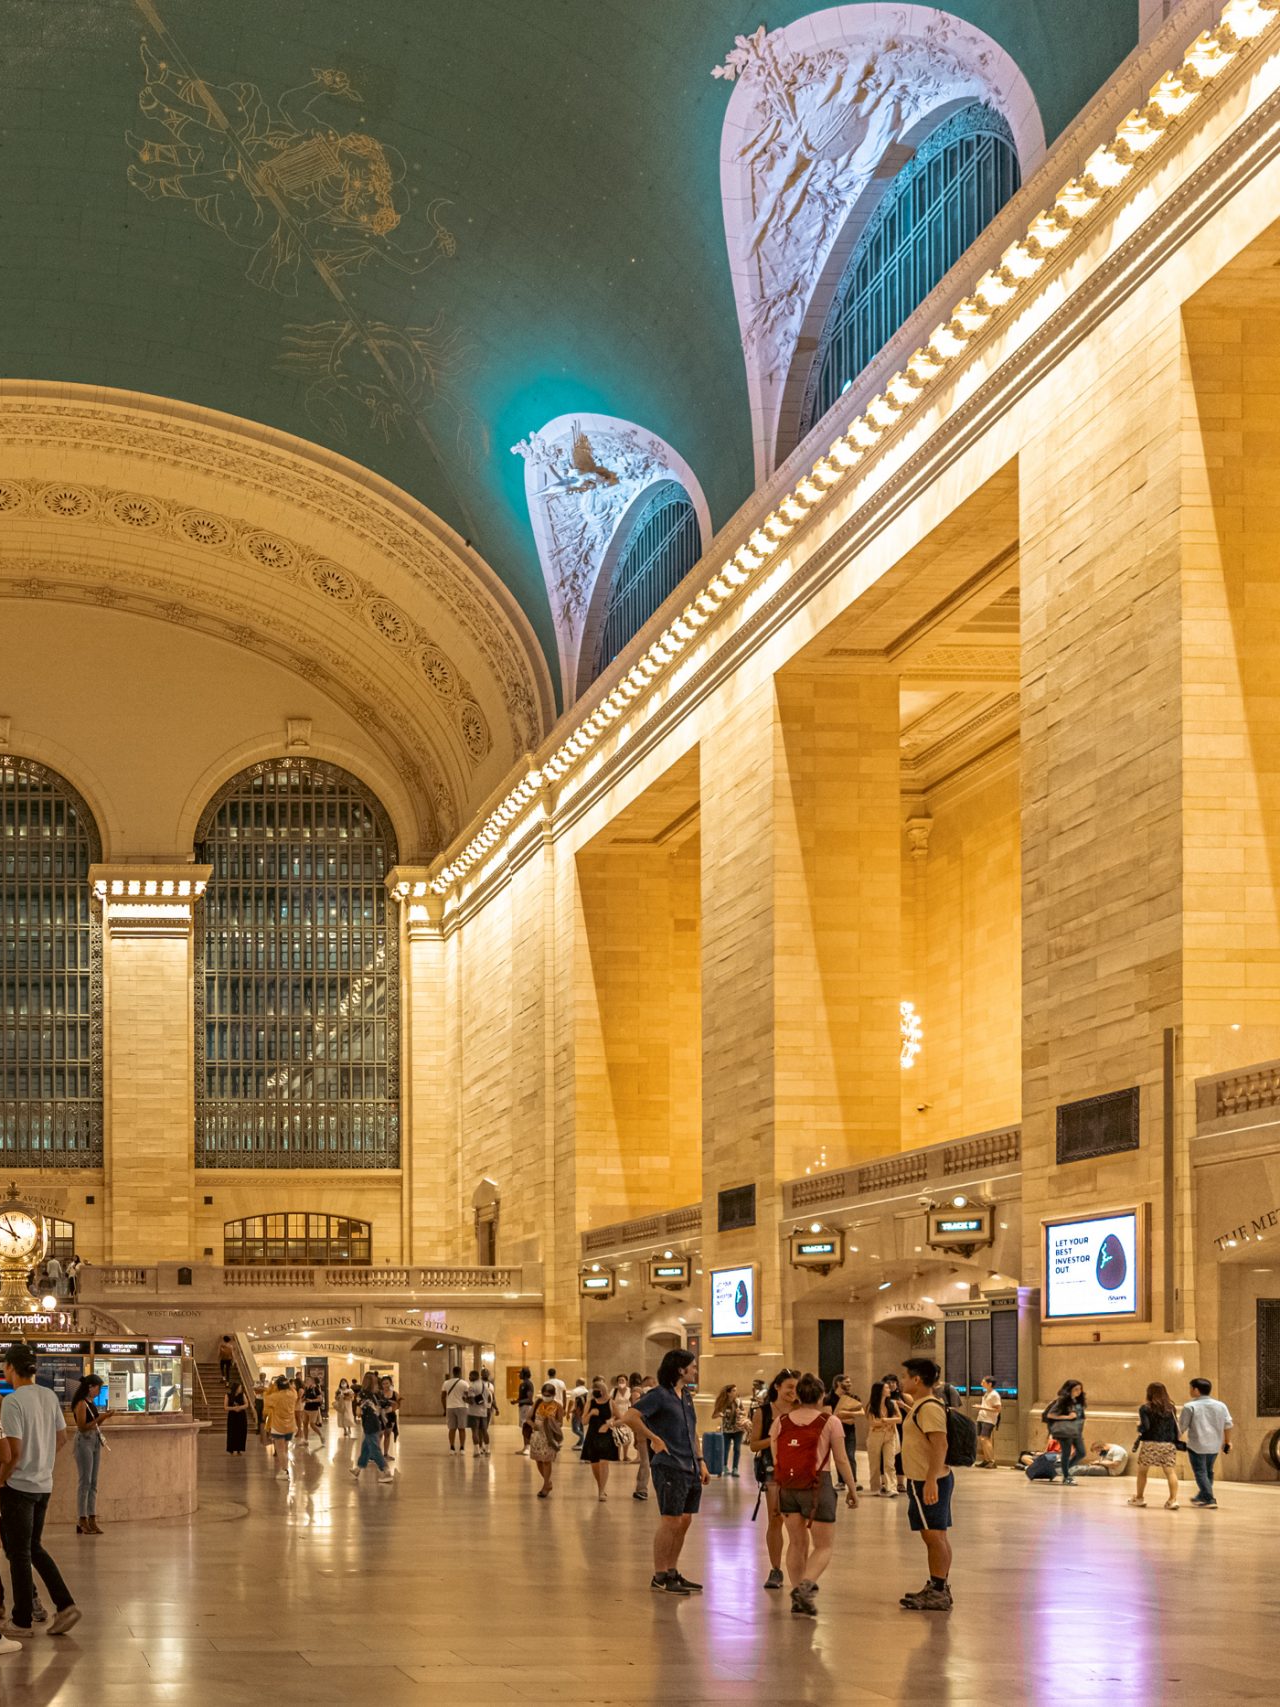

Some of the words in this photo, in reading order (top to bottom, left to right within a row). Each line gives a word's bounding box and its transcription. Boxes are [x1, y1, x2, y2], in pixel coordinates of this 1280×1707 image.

[22, 1195, 59, 1206] AVENUE
[941, 1222, 968, 1231] TRACK
[1055, 1239, 1068, 1247] LET
[1069, 1236, 1089, 1245] YOUR
[1213, 1225, 1249, 1251] THE
[1055, 1247, 1072, 1256] BEST
[1055, 1255, 1090, 1265] INVESTOR
[893, 1303, 916, 1312] TRACK
[267, 1322, 298, 1333] TICKET
[301, 1316, 352, 1328] MACHINES
[384, 1316, 422, 1327] TRACKS
[435, 1321, 448, 1329] TO
[449, 1325, 460, 1333] 42
[312, 1343, 348, 1352] WAITING
[351, 1346, 374, 1355] ROOM
